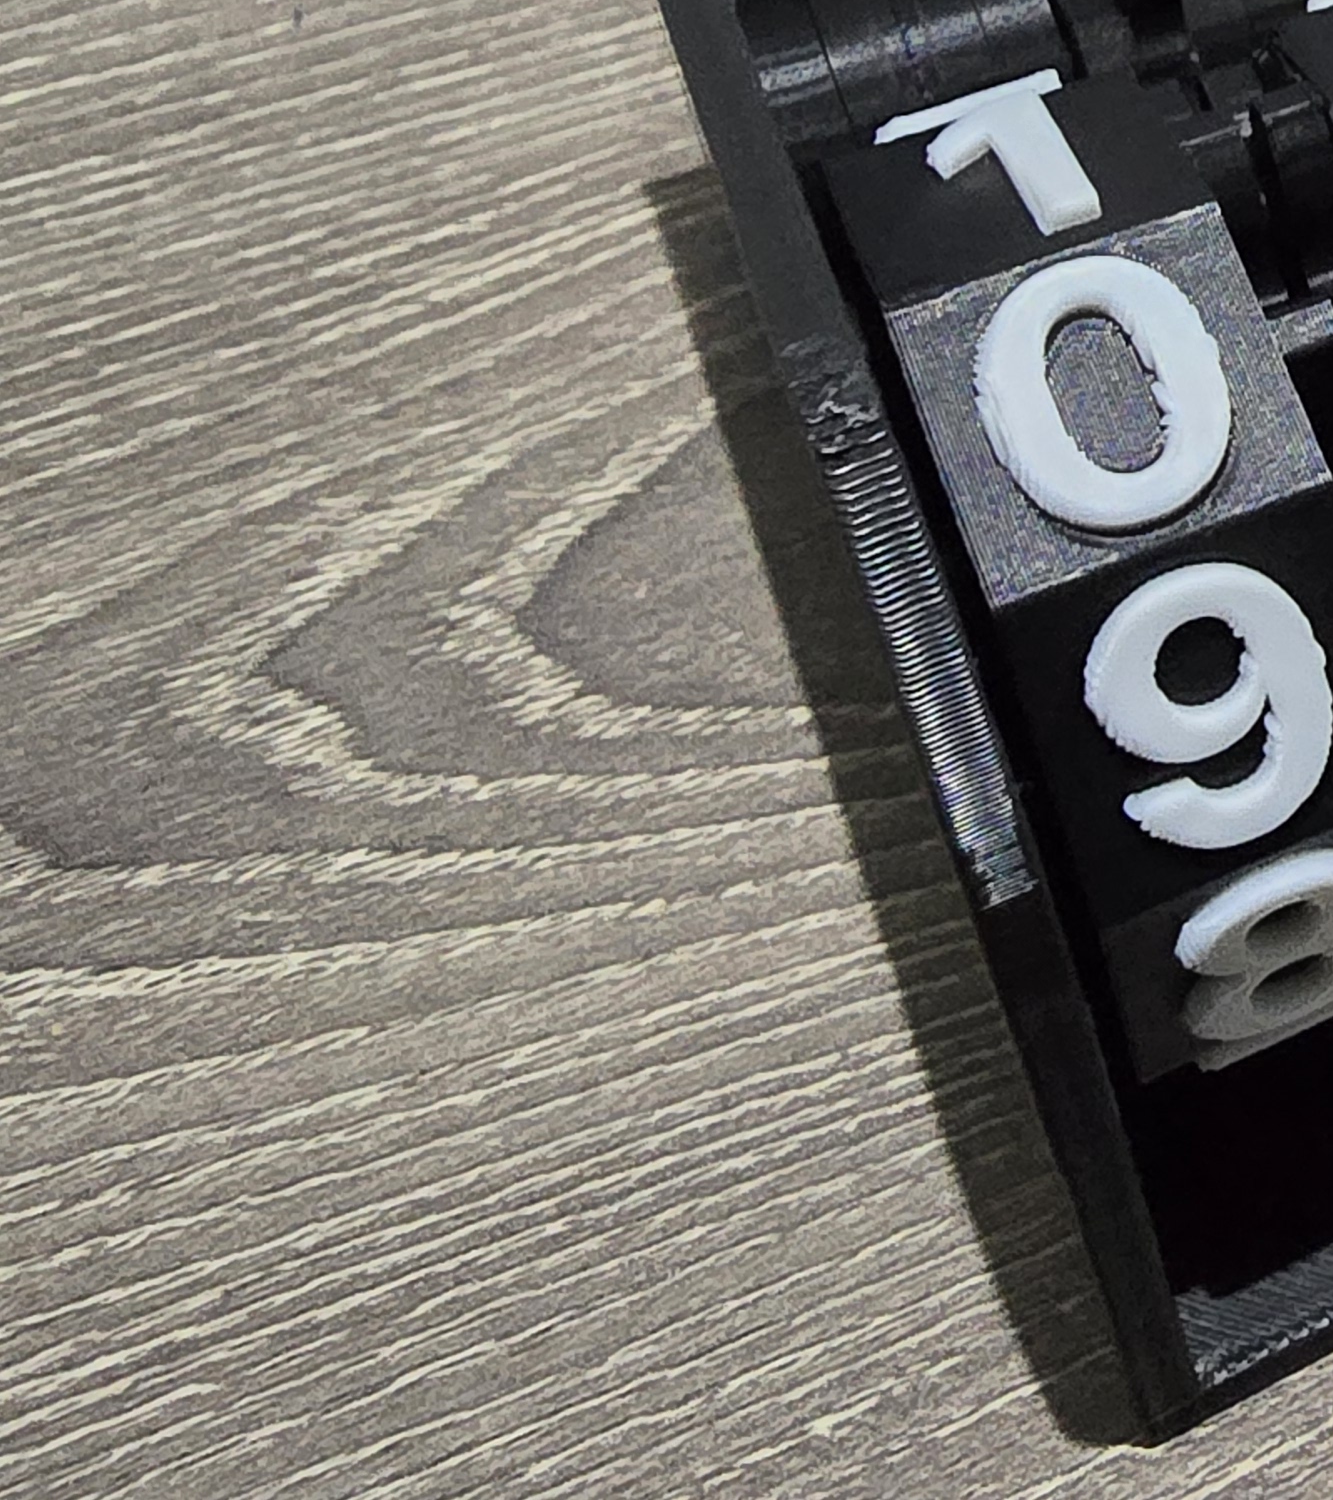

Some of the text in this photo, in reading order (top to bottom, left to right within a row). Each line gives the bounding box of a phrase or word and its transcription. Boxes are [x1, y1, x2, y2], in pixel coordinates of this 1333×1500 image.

[927, 86, 1102, 236] 1
[974, 255, 1232, 528] 0
[1084, 562, 1333, 849] 9
